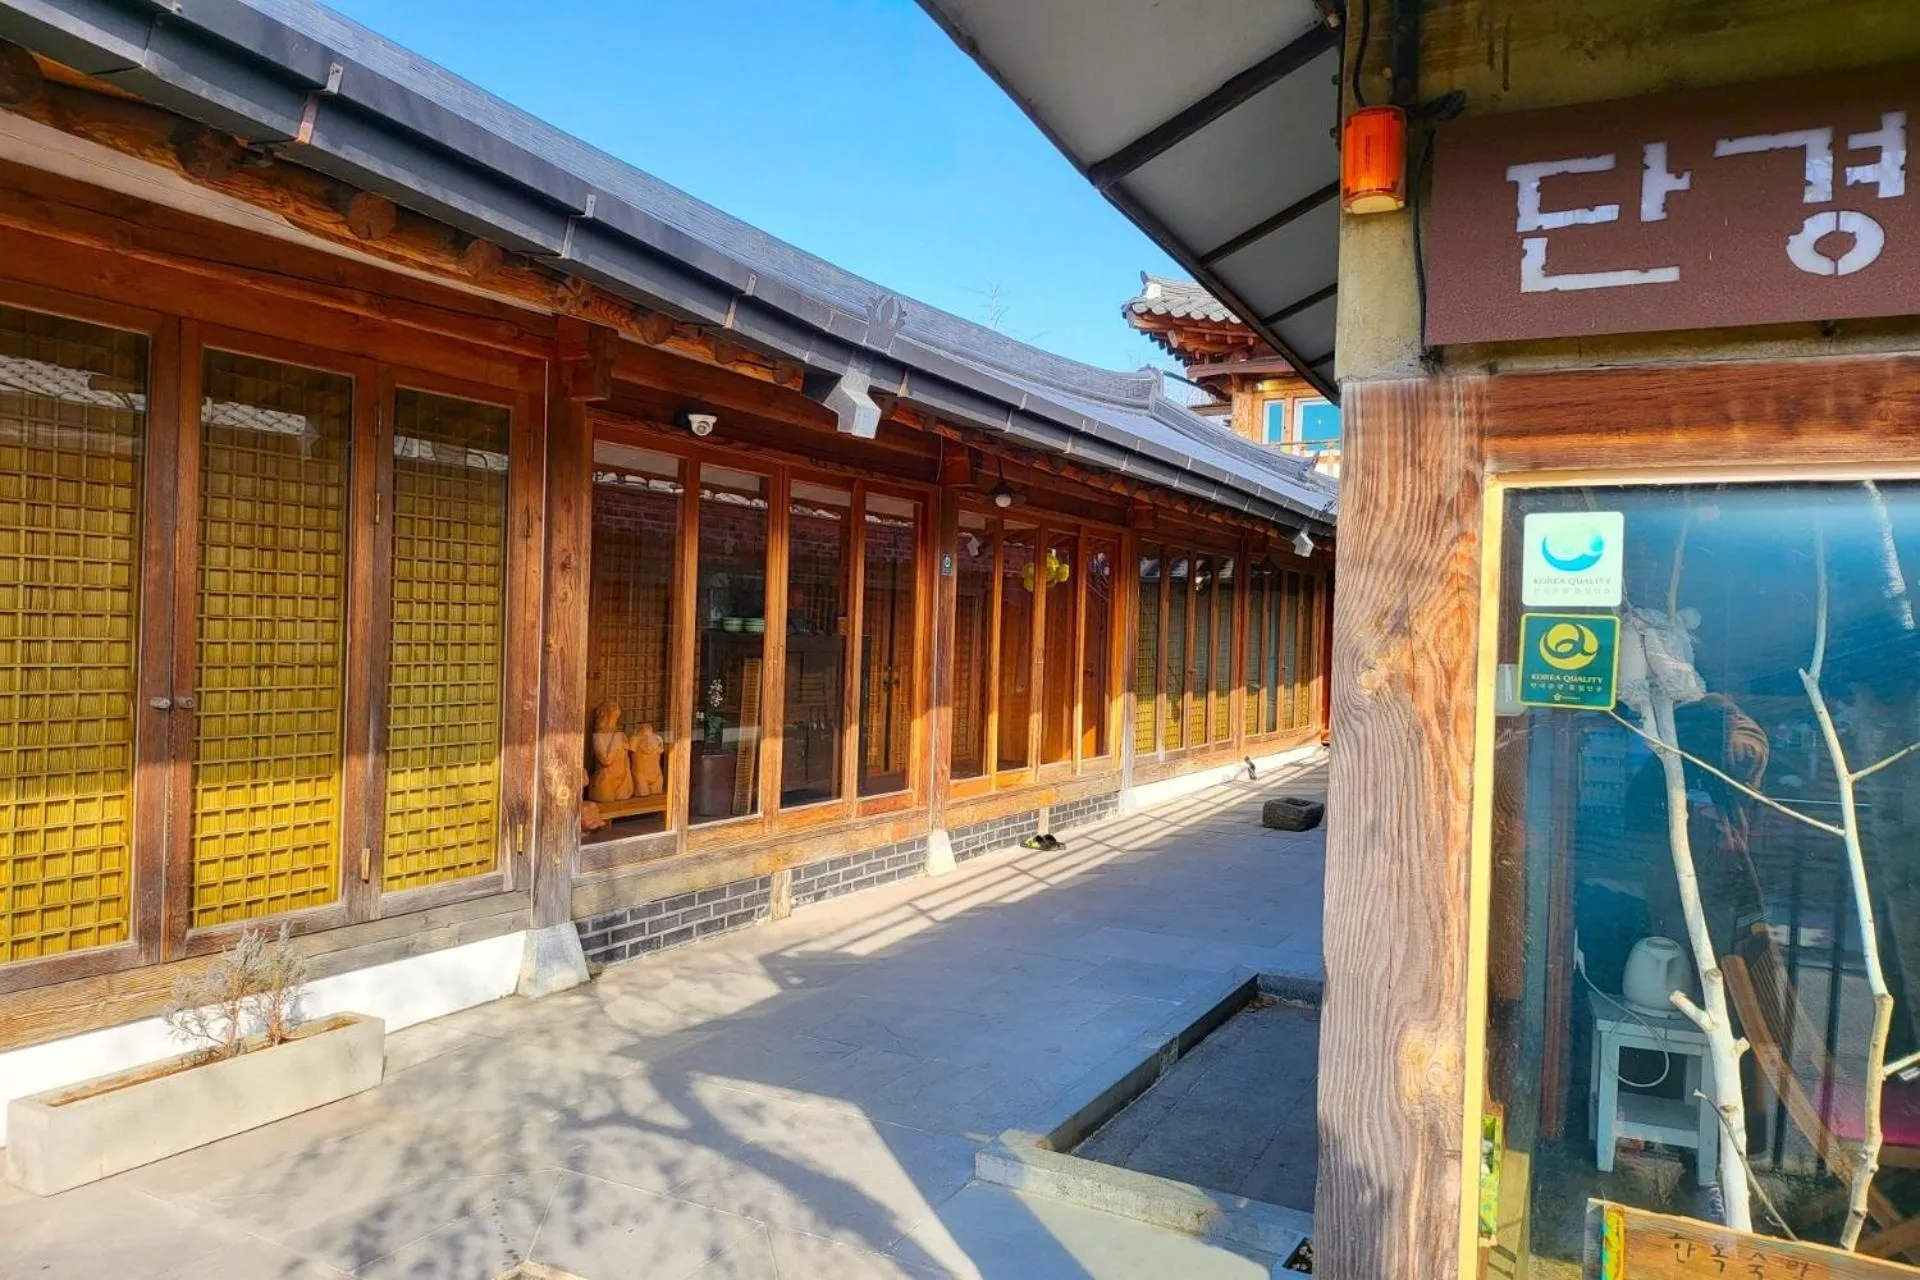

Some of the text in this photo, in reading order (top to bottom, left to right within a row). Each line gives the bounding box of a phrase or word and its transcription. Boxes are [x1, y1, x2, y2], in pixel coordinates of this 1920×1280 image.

[1506, 111, 1907, 293] 단경
[1533, 576, 1612, 586] KOREA QUALITY
[1531, 673, 1604, 684] KOREA QUALITY
